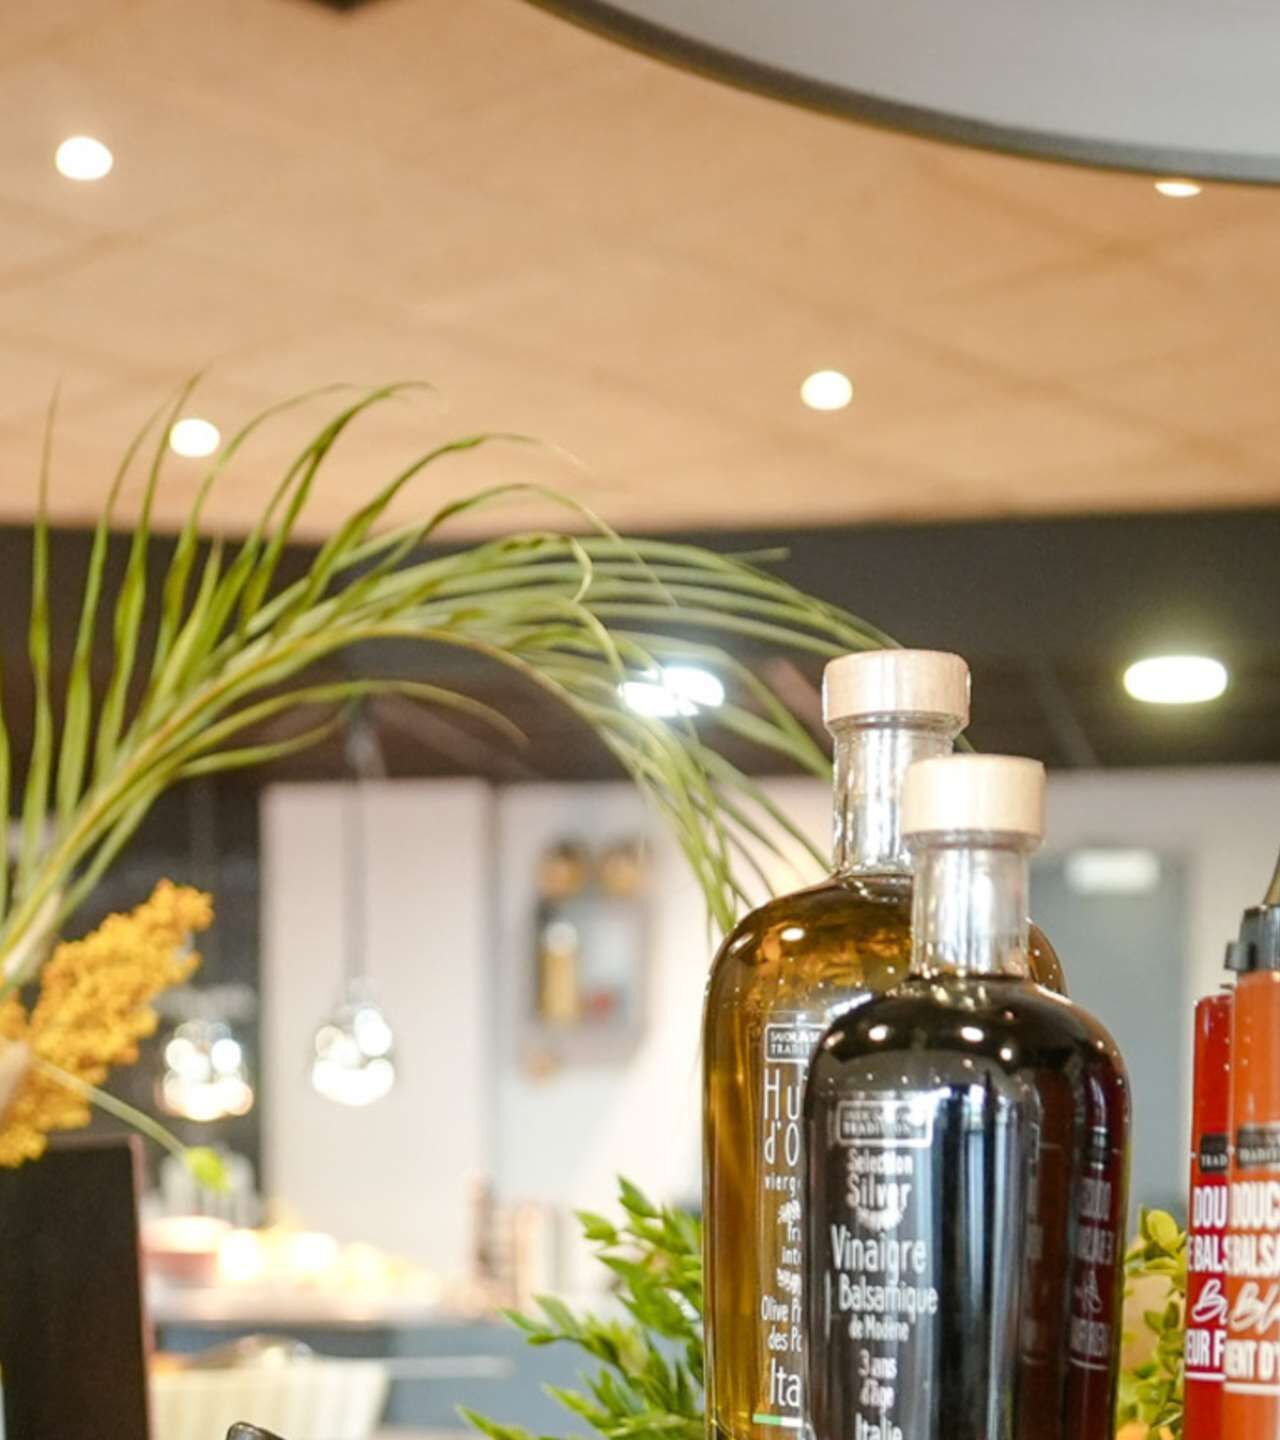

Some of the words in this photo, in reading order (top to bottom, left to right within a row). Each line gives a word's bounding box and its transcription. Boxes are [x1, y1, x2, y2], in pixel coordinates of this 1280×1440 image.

[846, 1172, 912, 1207] Silver
[831, 1224, 927, 1285] Vinaigre
[839, 1273, 938, 1323] Balsamique
